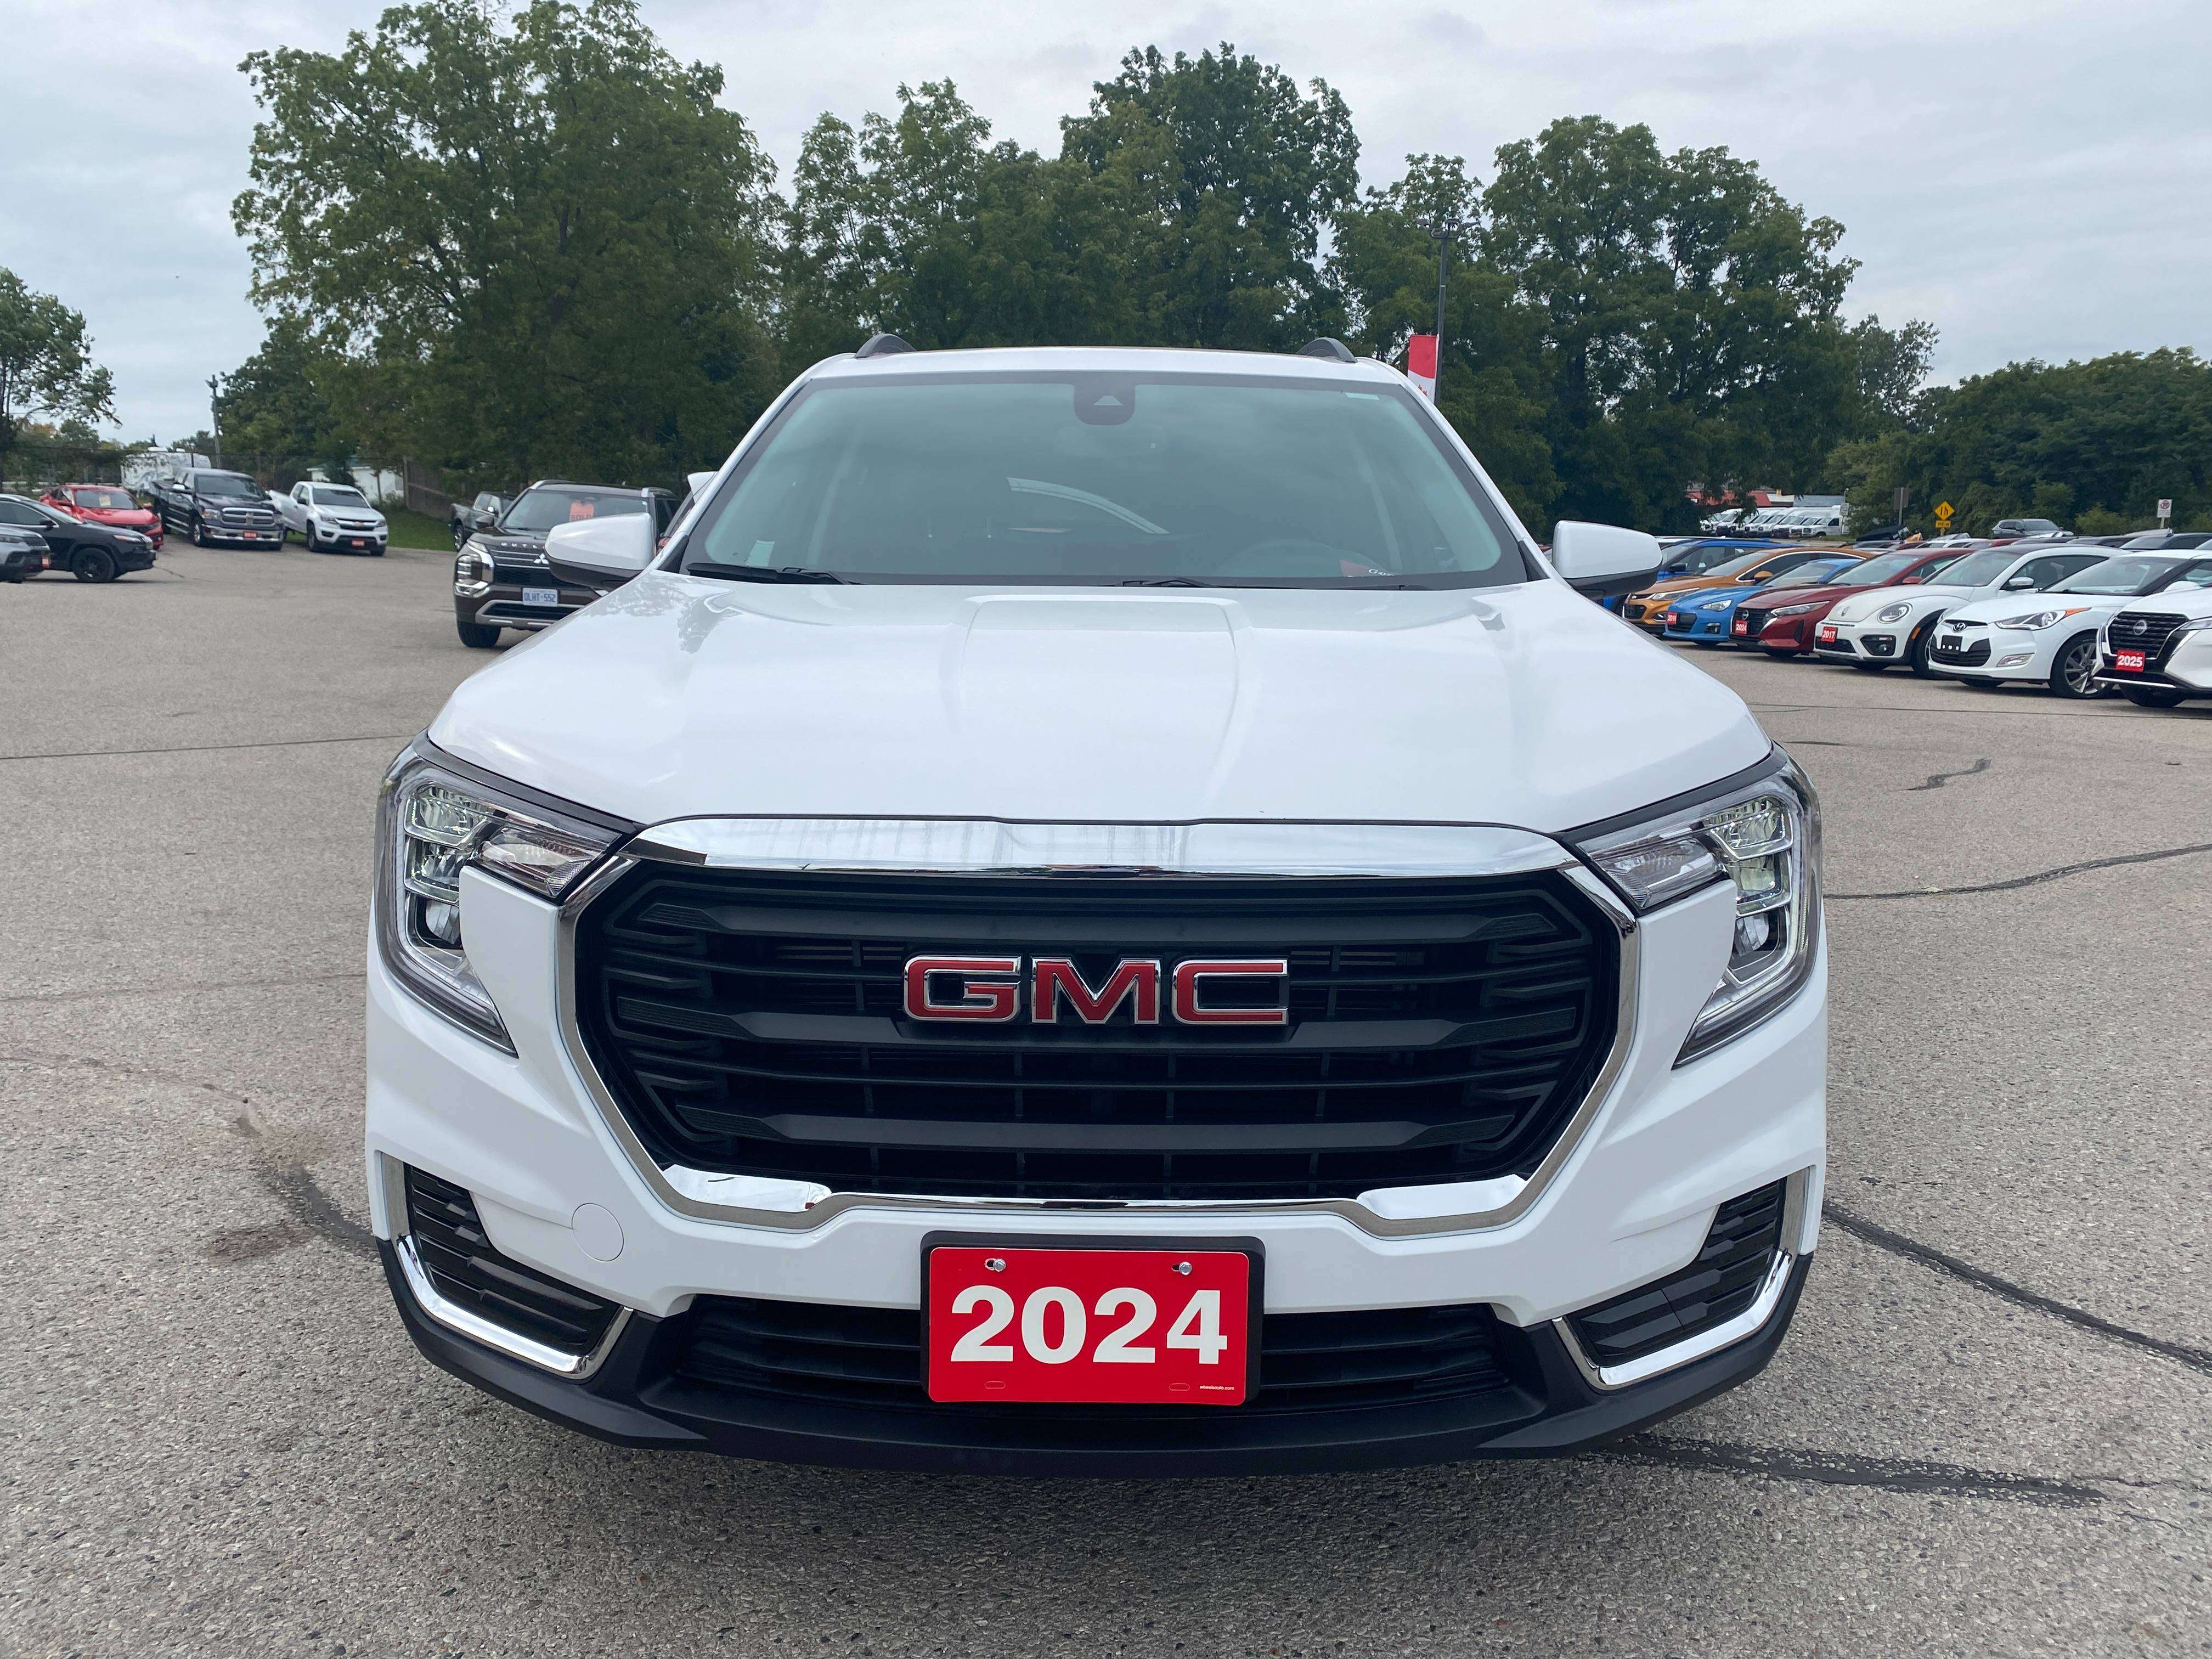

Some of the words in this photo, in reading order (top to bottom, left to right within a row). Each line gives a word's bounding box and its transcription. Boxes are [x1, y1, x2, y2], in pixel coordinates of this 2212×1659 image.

[1822, 630, 1836, 639] 2017
[2118, 655, 2142, 667] 2025
[904, 955, 1289, 1025] GMC
[951, 1285, 1227, 1364] 2024
